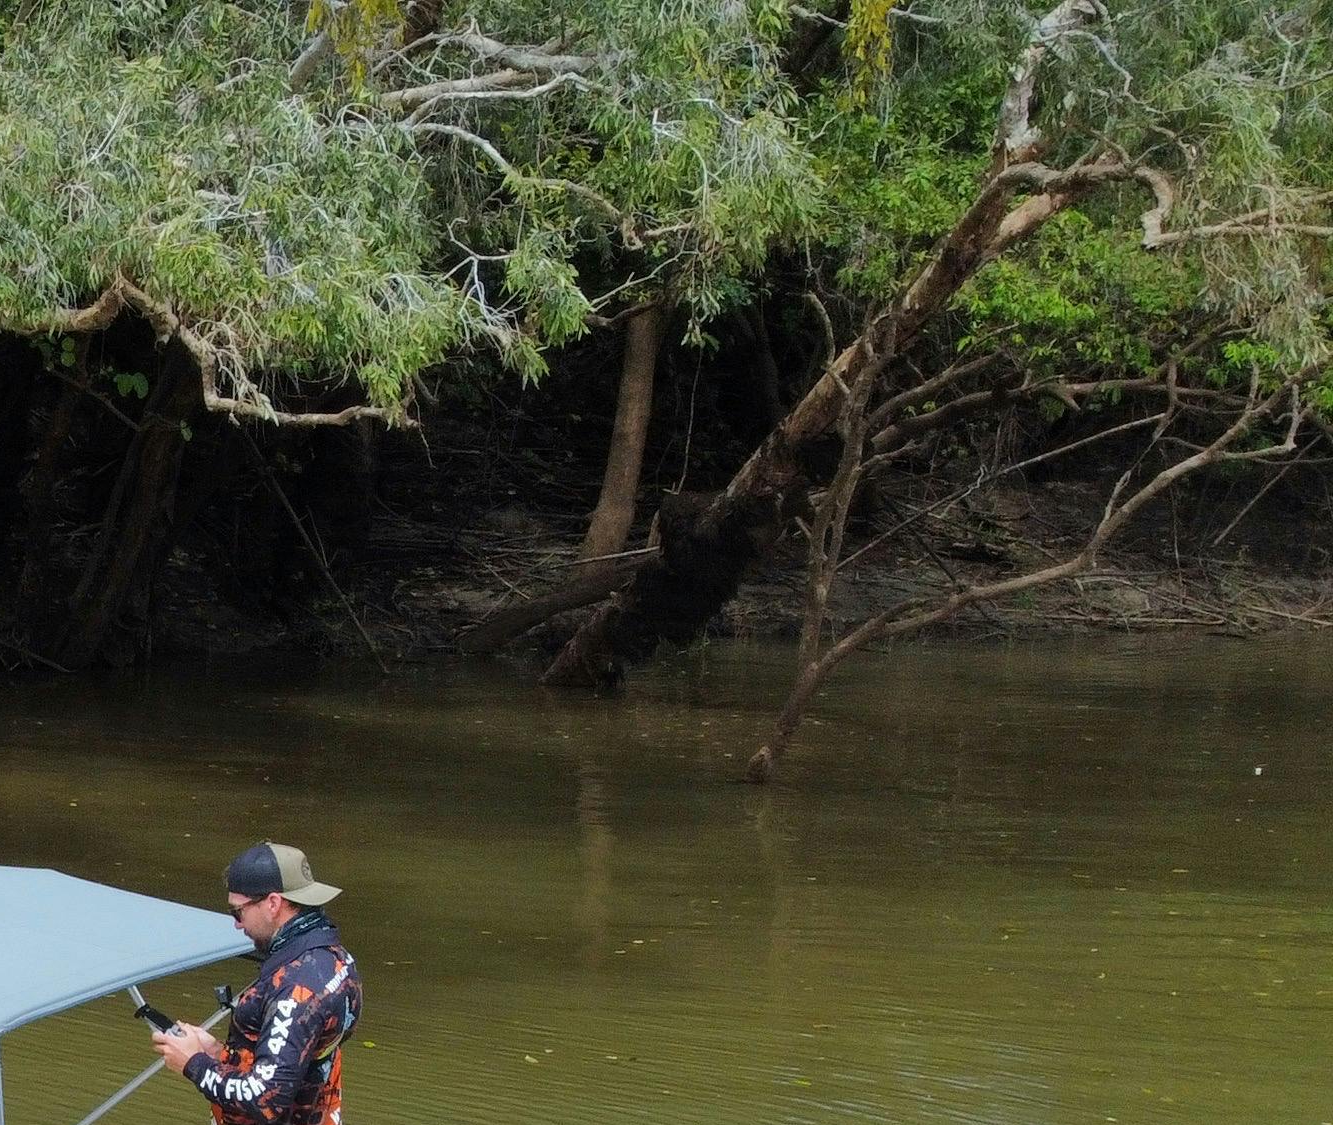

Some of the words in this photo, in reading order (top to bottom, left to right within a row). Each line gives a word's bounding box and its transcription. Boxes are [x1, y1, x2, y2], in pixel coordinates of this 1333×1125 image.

[200, 1068, 223, 1097] NT
[225, 1076, 266, 1101] FISH
[267, 999, 297, 1055] 4X4
